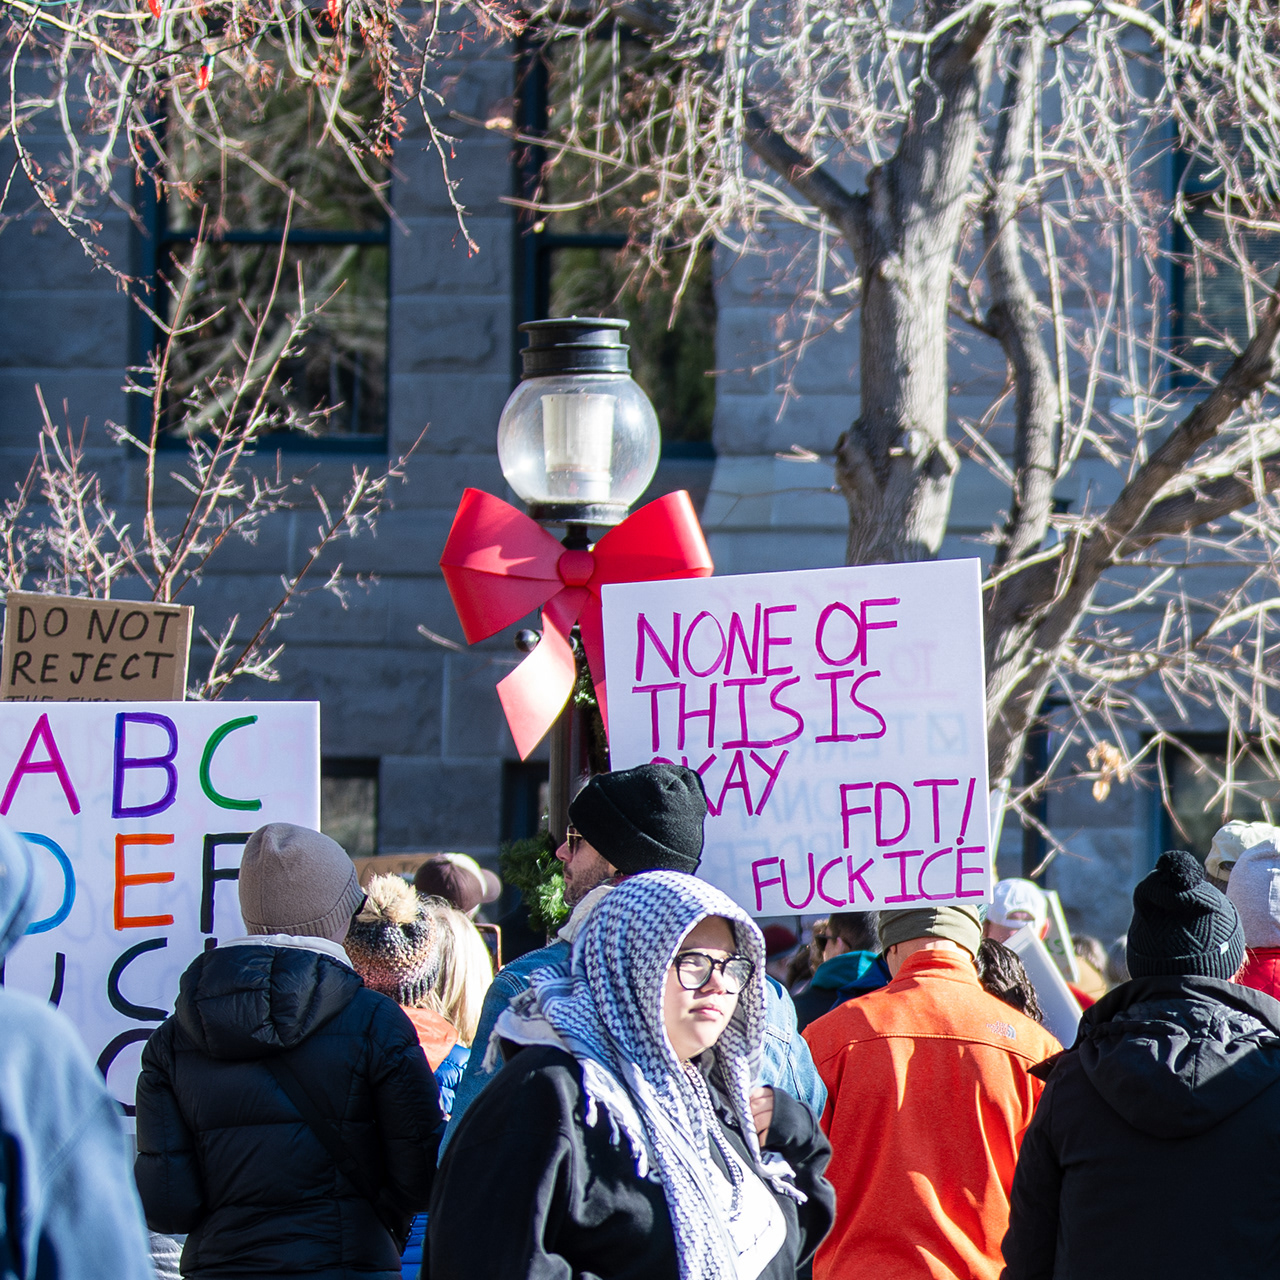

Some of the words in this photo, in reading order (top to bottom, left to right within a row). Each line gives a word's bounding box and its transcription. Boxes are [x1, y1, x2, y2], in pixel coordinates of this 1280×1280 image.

[17, 606, 68, 643] DO
[87, 608, 181, 644] NOT
[635, 602, 798, 681] NONE
[815, 597, 900, 667] OF
[11, 651, 175, 686] REJECT
[632, 675, 804, 752] THIS
[815, 670, 887, 743] IS
[839, 777, 976, 849] FDT!
[752, 852, 875, 912] FUCK
[884, 846, 986, 904] ICE
